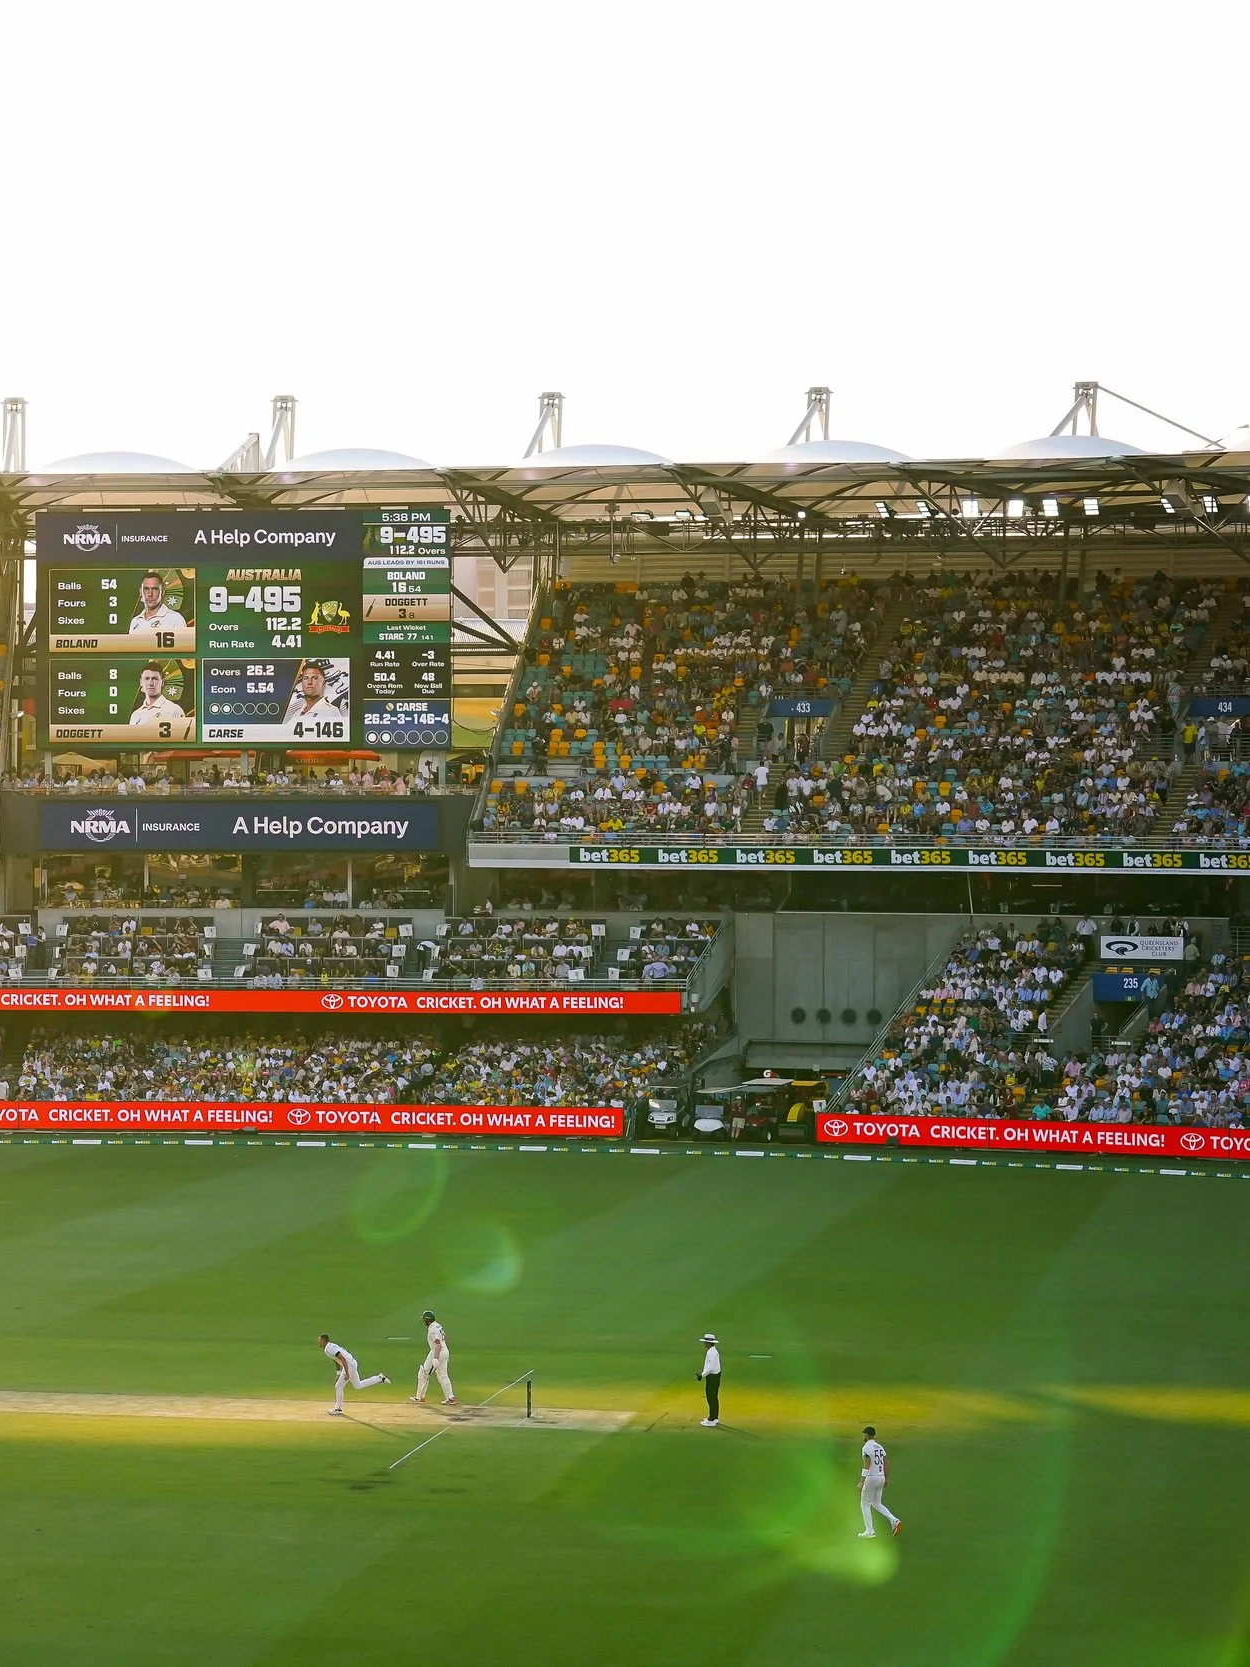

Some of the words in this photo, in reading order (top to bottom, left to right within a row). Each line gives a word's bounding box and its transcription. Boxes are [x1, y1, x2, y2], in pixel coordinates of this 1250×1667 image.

[382, 513, 408, 521] 5:38
[411, 513, 430, 521] PM
[63, 533, 112, 545] NRMA
[121, 535, 168, 543] INSURANCE
[194, 530, 207, 545] A
[211, 529, 251, 548] Help
[253, 529, 337, 547] Company
[380, 526, 446, 544] 9-495
[389, 545, 415, 555] 112.2
[418, 547, 446, 555] Overs
[226, 568, 302, 581] AUSTRALIA
[387, 571, 426, 580] BOLAND
[57, 582, 81, 590] Balls
[101, 579, 117, 590] 54
[392, 582, 407, 593] 16
[58, 599, 86, 607] Fours
[109, 596, 117, 607] 3
[209, 586, 302, 613] 9-495
[385, 598, 428, 606] DOGGETT
[58, 616, 85, 625] Sixes
[109, 613, 118, 624] 0
[398, 608, 407, 619] 3
[209, 623, 239, 631] Overs
[266, 617, 302, 631] 112.2
[55, 639, 98, 649] BOLAND
[155, 632, 175, 648] 16
[209, 640, 229, 648] Run
[231, 640, 255, 648] Rate
[271, 634, 302, 648] 4.41
[379, 633, 404, 641] STARC
[407, 633, 418, 641] 77
[375, 651, 395, 660] 4.41
[421, 650, 435, 660] -3
[58, 672, 82, 680] Balls
[109, 669, 118, 680] 8
[210, 668, 241, 676] Overs
[246, 665, 275, 676] 26.2
[374, 672, 396, 682] 50.4
[421, 672, 435, 682] 48
[58, 689, 86, 697] Fours
[109, 686, 118, 697] 0
[210, 686, 236, 694] Econ
[246, 682, 275, 694] 5.54
[58, 706, 85, 715] Sixes
[109, 703, 118, 715] 0
[396, 702, 428, 712] CARSE
[796, 702, 811, 713] 433
[1217, 701, 1233, 713] 434
[364, 713, 449, 725] 26.2-3-146-4
[55, 729, 103, 739] DOGGETT
[158, 722, 172, 739] 3
[208, 729, 244, 738] CARSE
[293, 722, 344, 738] 4-146
[70, 820, 131, 834] NRMA
[143, 822, 200, 832] INSURANCE
[233, 816, 249, 834] A
[254, 816, 302, 838] Help
[306, 816, 409, 838] Company
[579, 848, 640, 863] bet365
[658, 848, 719, 863] bet365
[736, 849, 796, 864] bet365
[813, 849, 873, 864] bet365
[891, 850, 951, 865] bet365
[968, 850, 1027, 865] bet365
[1046, 851, 1105, 866] bet365
[1123, 852, 1182, 867] bet365
[1123, 977, 1138, 989] 235
[348, 996, 407, 1008] TOYOTA
[417, 997, 476, 1008] CRICKET.
[480, 997, 501, 1008] OH
[505, 997, 546, 1008] WHAT
[550, 997, 559, 1008] A
[564, 997, 623, 1009] FEELING!
[49, 1109, 113, 1122] CRICKET.
[118, 1110, 140, 1121] OH
[145, 1110, 189, 1121] WHAT
[193, 1110, 203, 1121] A
[208, 1110, 272, 1122] FEELING!
[854, 1123, 919, 1137] TOYOTA
[931, 1126, 999, 1140] CRICKET.
[1004, 1128, 1028, 1141] OH
[1033, 1129, 1078, 1143] WHAT
[1083, 1131, 1093, 1143] A
[1098, 1132, 1165, 1147] FEELING!
